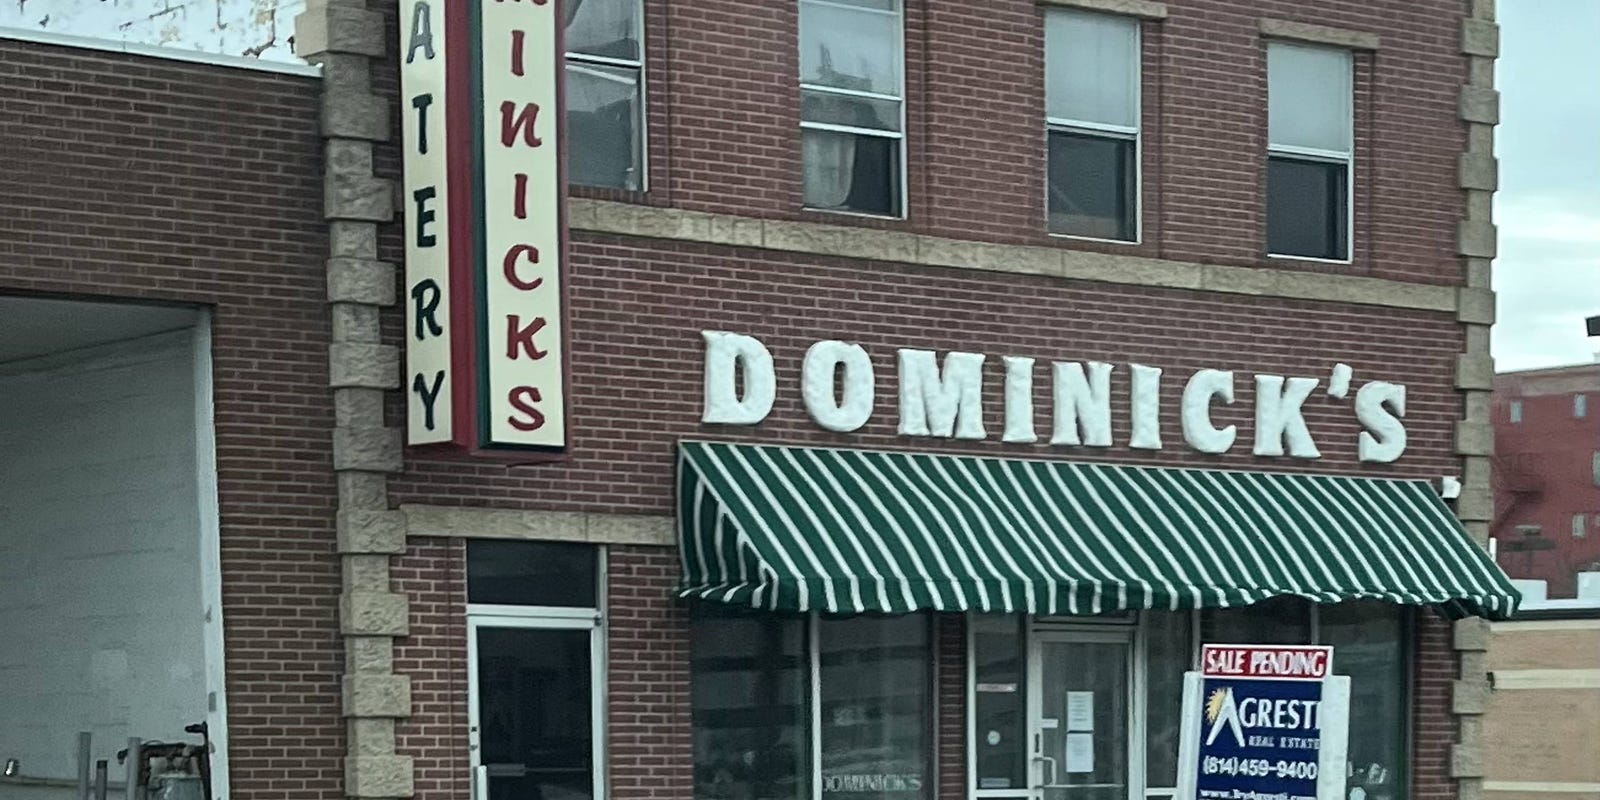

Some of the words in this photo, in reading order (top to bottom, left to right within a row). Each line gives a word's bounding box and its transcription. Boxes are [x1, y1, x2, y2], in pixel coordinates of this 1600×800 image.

[496, 0, 548, 432] INICKS
[701, 330, 1407, 463] DOMINICK'S
[1206, 650, 1246, 674] SALE
[1250, 651, 1325, 677] PENDING
[1248, 735, 1275, 748] REAL
[1280, 736, 1320, 750] ESTATE
